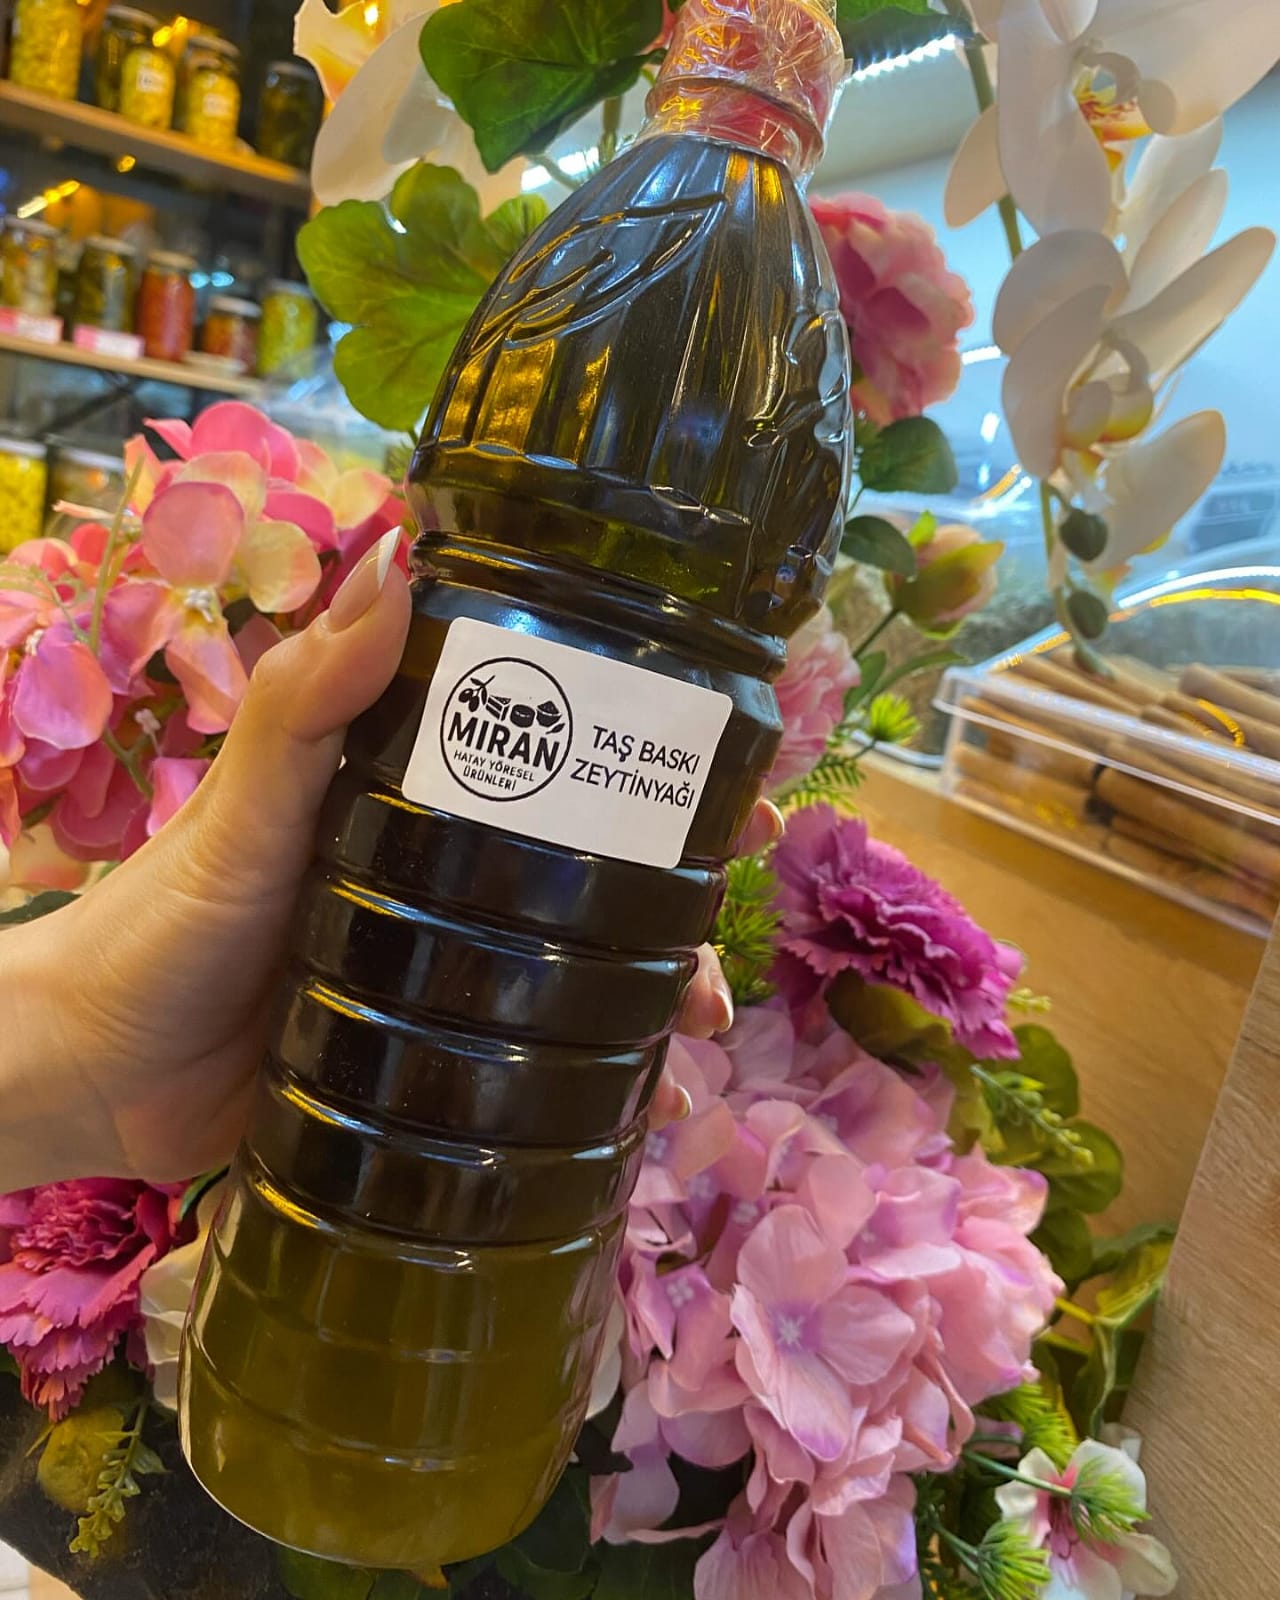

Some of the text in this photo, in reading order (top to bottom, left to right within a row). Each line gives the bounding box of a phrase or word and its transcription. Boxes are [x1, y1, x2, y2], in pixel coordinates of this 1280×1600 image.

[447, 711, 560, 772] MIRAN
[453, 749, 535, 782] HATAY YÖRESEL
[592, 725, 701, 775] TAŞ BASKI
[462, 765, 517, 792] ÜRÜNLERİ
[570, 758, 695, 810] ZEYTİNYAĞI
